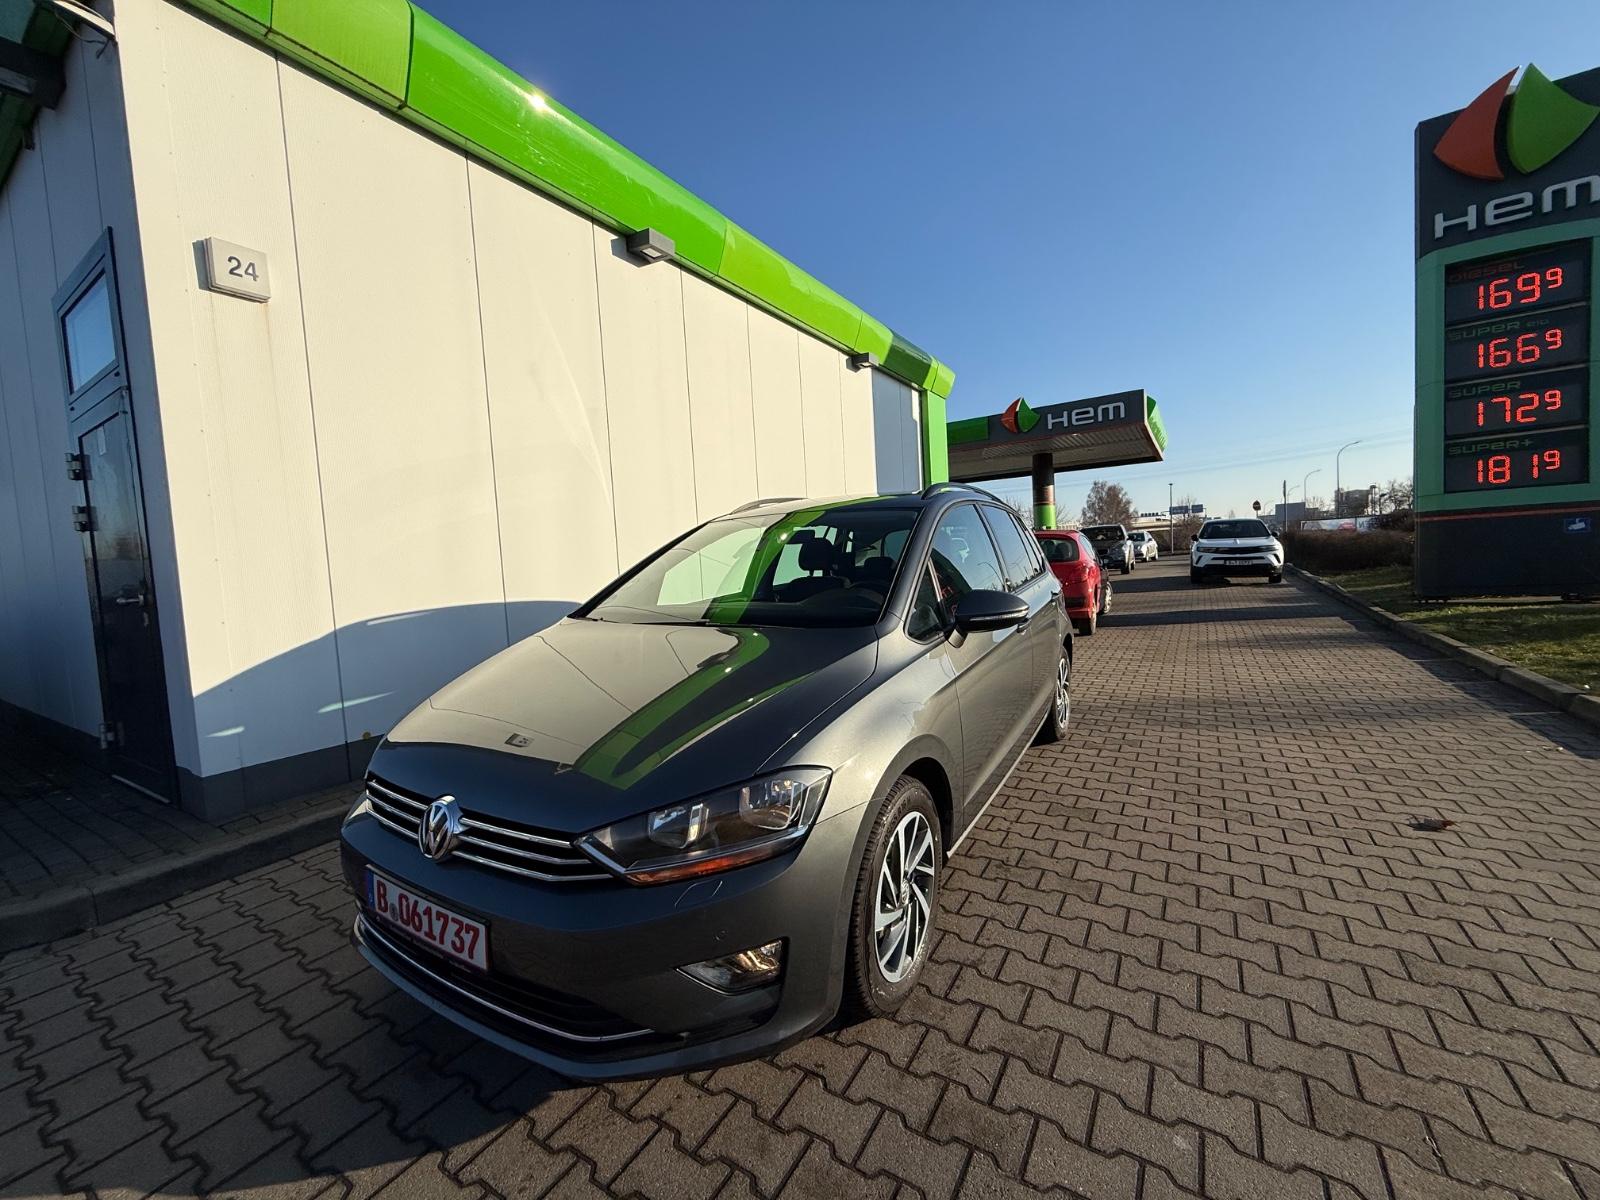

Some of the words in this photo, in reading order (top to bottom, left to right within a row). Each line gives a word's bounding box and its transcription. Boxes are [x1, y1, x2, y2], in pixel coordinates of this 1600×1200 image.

[227, 255, 260, 282] 24
[376, 879, 389, 914] B
[398, 892, 480, 961] 061737
